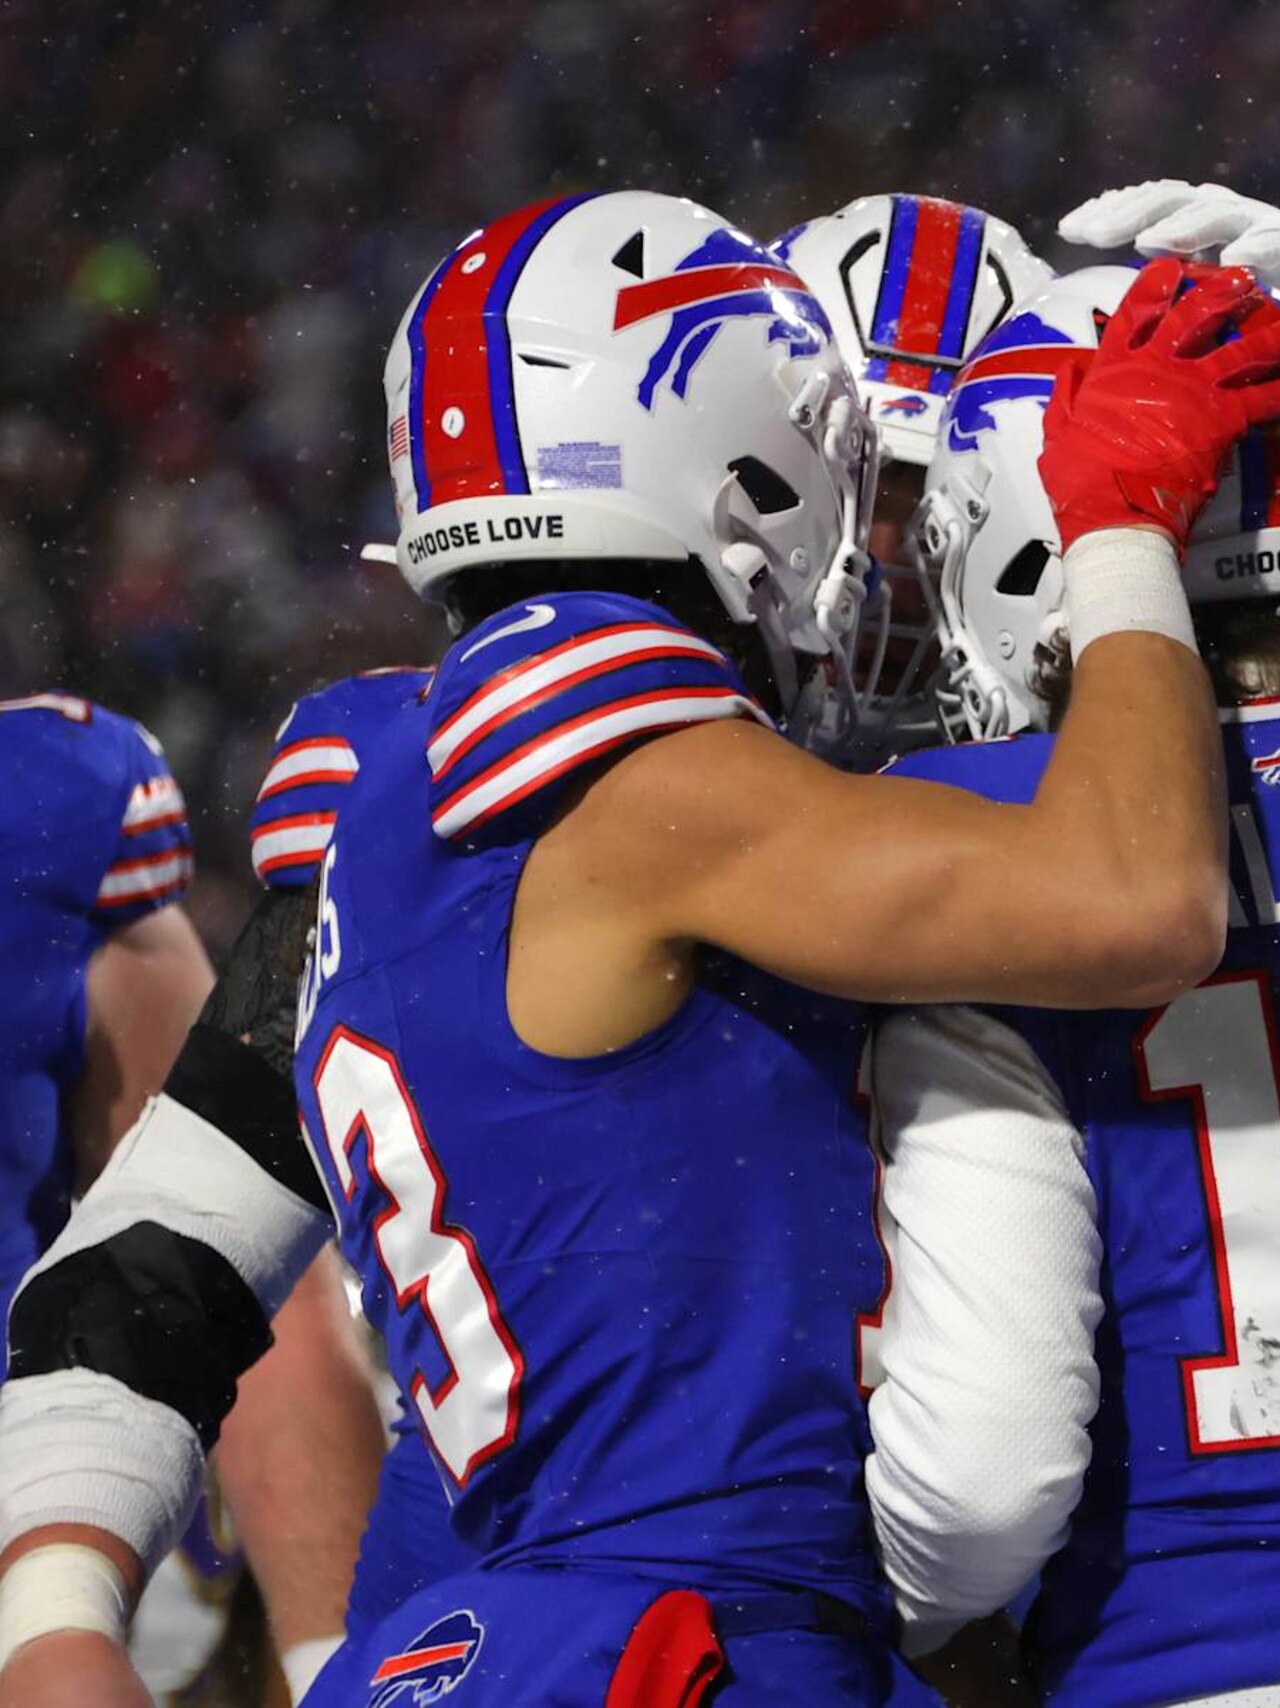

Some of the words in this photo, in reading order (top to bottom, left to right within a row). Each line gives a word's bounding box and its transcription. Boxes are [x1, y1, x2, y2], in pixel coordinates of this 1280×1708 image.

[407, 522, 480, 564] CHOOSE
[487, 515, 563, 542] LOVE
[299, 1022, 526, 1505] 3
